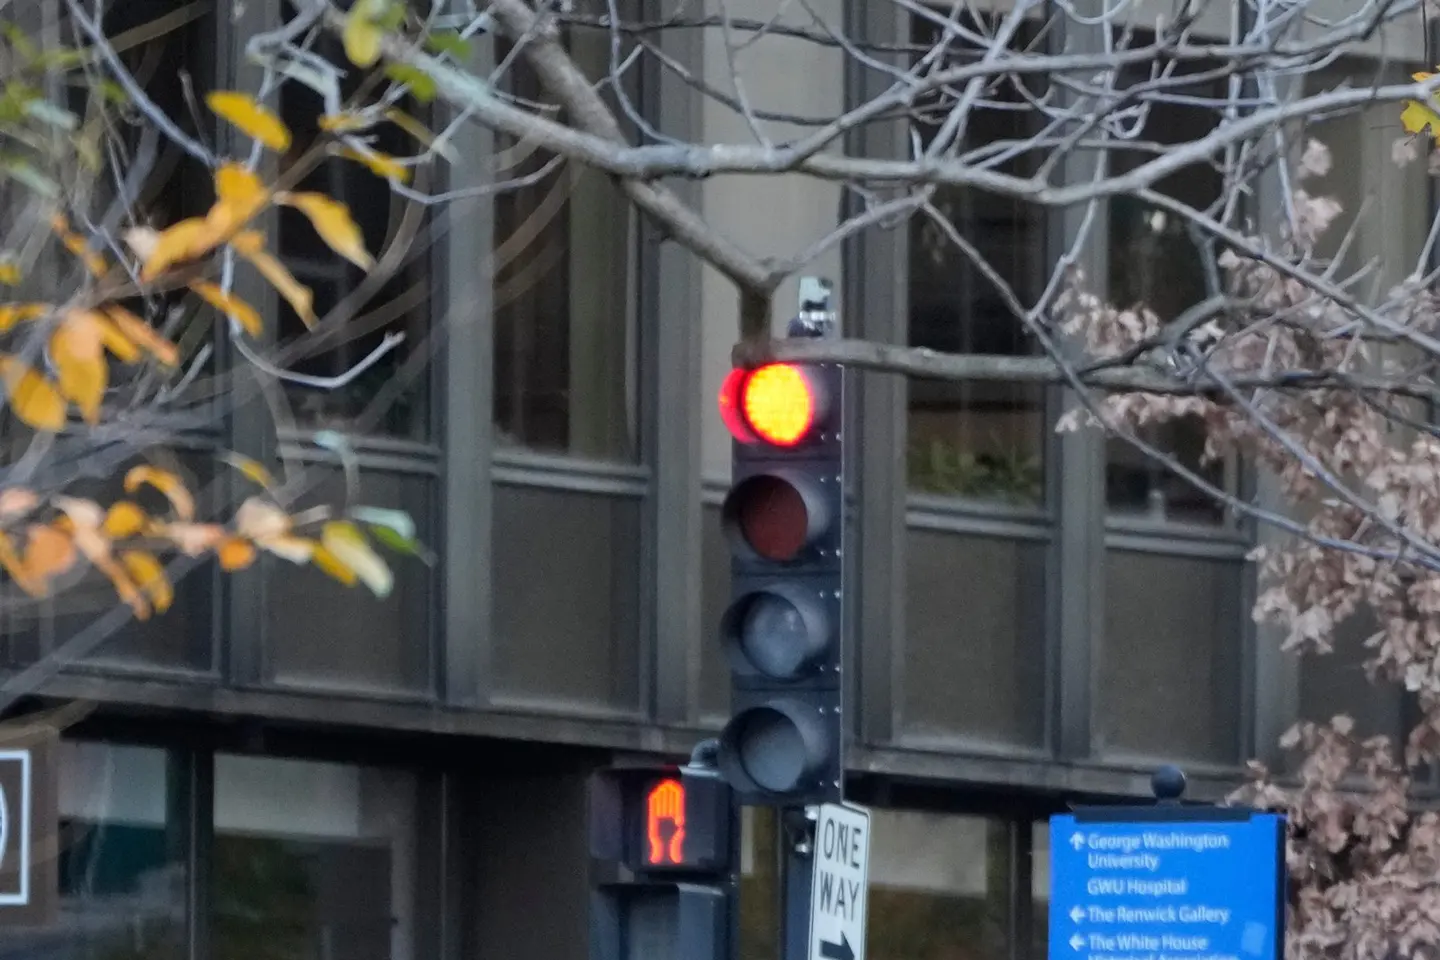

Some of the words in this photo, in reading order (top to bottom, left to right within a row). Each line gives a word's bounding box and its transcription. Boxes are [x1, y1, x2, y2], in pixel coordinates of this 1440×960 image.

[823, 818, 861, 870] ONE
[1088, 833, 1141, 852] George
[1142, 832, 1229, 852] Washington
[1088, 853, 1159, 871] University
[820, 870, 859, 921] WAY
[1088, 878, 1124, 895] GWU
[1127, 878, 1187, 897] Hospital
[1088, 906, 1115, 921] The
[1117, 906, 1176, 922] Renwick
[1179, 906, 1229, 924] Gallery
[1088, 934, 1114, 950] The
[1116, 934, 1158, 950] White
[1161, 934, 1208, 950] House
